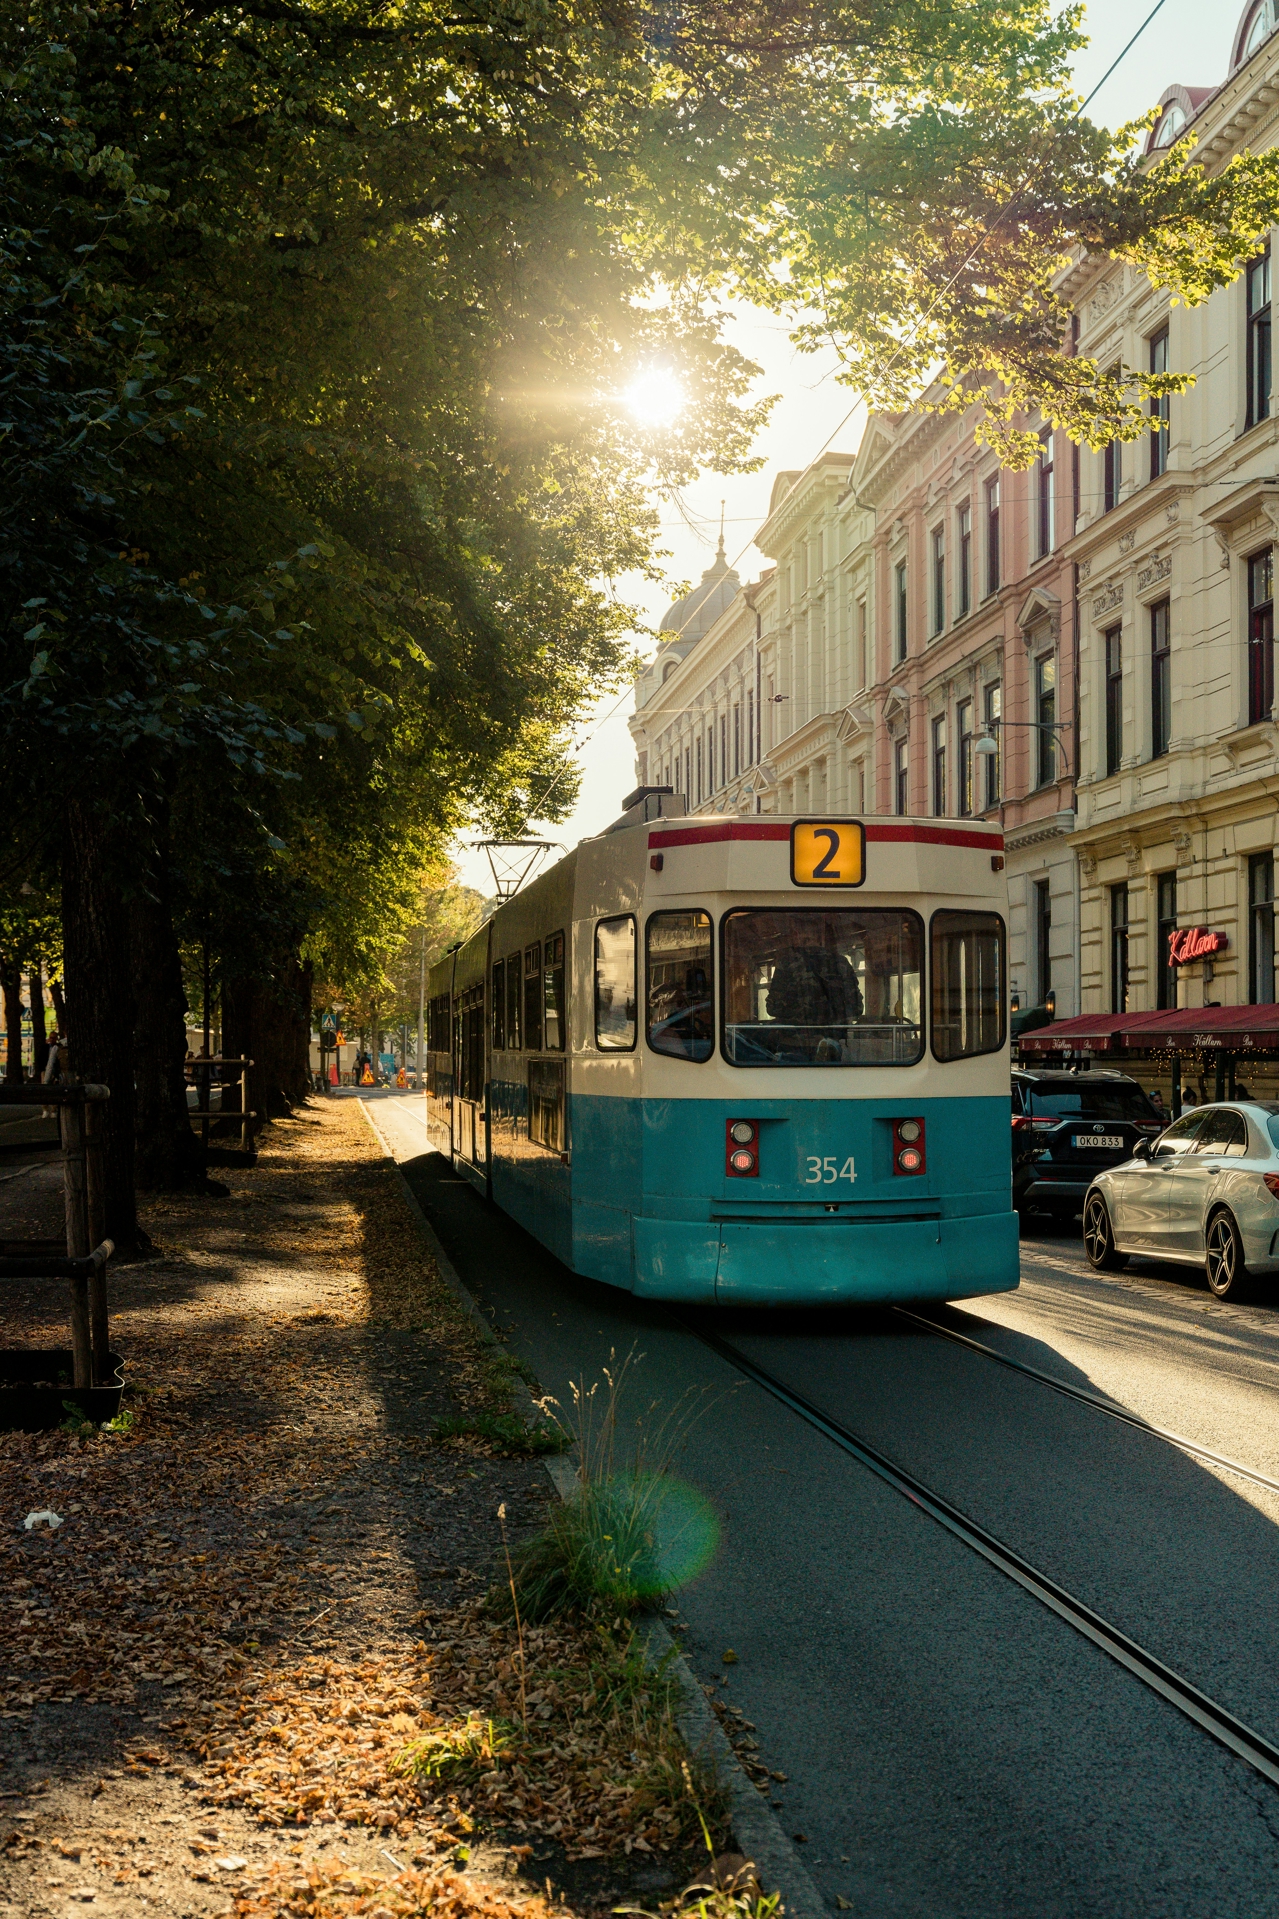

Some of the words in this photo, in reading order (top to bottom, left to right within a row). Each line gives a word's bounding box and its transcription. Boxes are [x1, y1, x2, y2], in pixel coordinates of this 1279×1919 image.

[812, 827, 841, 879] 2
[1080, 1137, 1098, 1145] OKO
[1101, 1138, 1119, 1146] 833
[805, 1156, 858, 1184] 354
